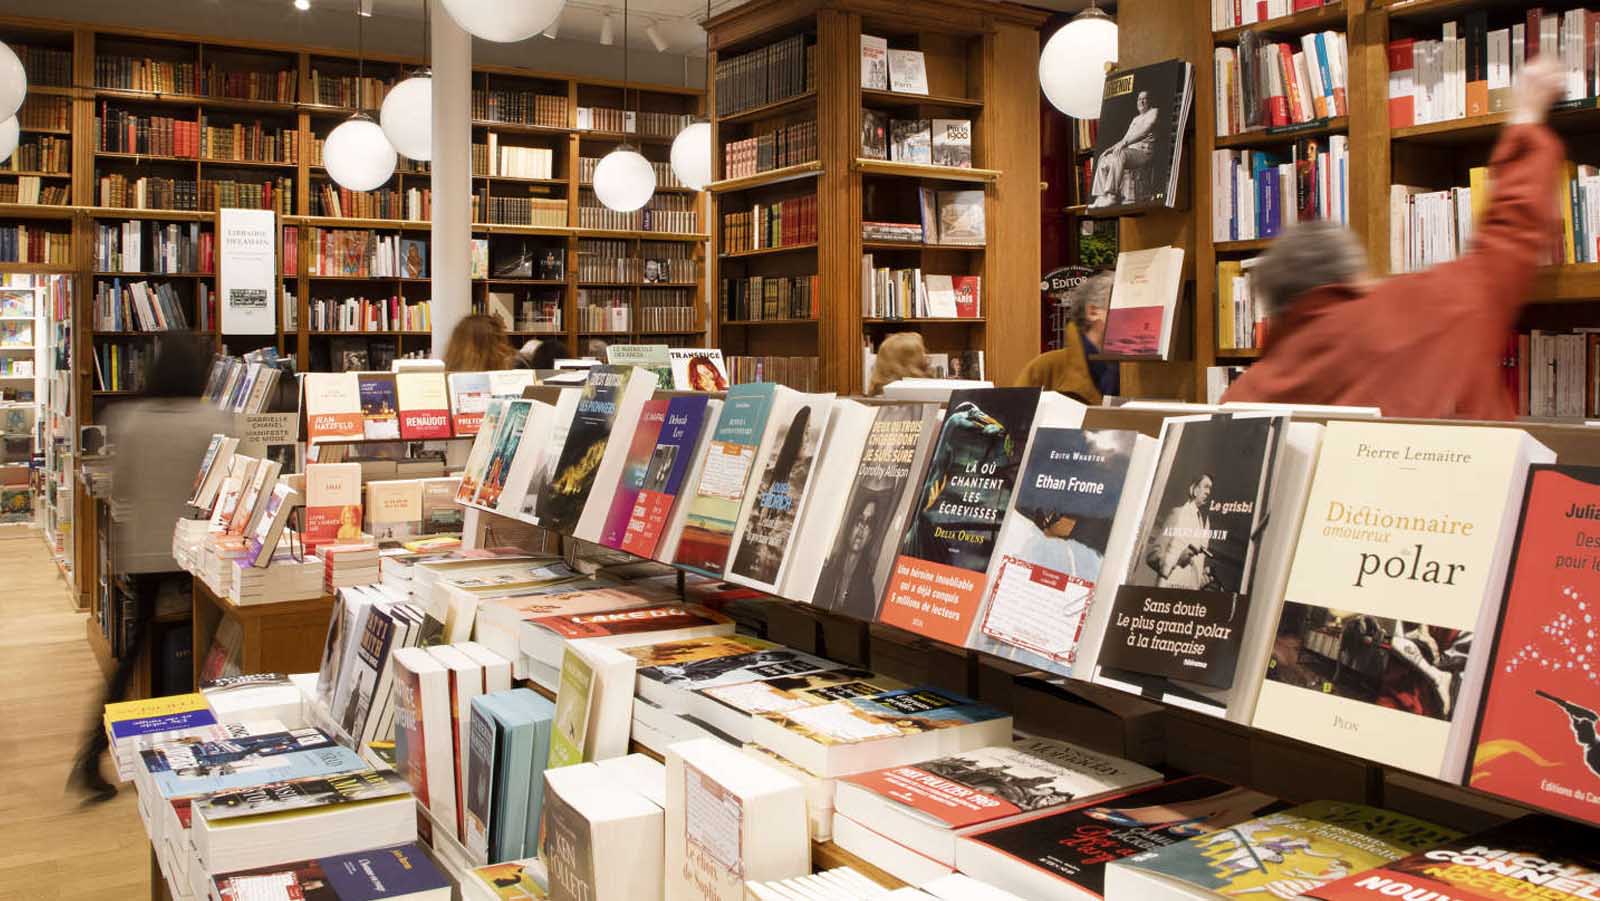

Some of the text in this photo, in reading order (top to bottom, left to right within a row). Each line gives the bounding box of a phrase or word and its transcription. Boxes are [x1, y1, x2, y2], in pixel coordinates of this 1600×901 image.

[315, 422, 353, 430] HATZFELD
[406, 416, 447, 426] RENAUDOT
[1356, 443, 1400, 460] Pierre
[859, 463, 909, 480] Dorothy Allison
[965, 460, 997, 475] LÀ OÙ
[951, 475, 1005, 490] CHANTENT
[1036, 474, 1105, 494] Ethan Frome
[963, 491, 981, 503] LES
[938, 501, 998, 520] ÉCREVISSES
[1210, 500, 1253, 514] Le grisbi
[1327, 500, 1474, 537] Dictionnaire
[1322, 525, 1392, 544] amoureux
[1576, 530, 1600, 548] Des
[1352, 544, 1465, 587] polar
[1555, 555, 1587, 569] pour
[900, 581, 911, 593] qui
[935, 572, 974, 592] inoubliable
[890, 591, 961, 621] 5 millions de lecteurs
[1143, 597, 1207, 618] Sans doute
[1116, 613, 1232, 641] Le plus grand polar
[1127, 632, 1206, 656] à la française
[1540, 779, 1573, 797] Éditions
[1573, 788, 1586, 800] du
[555, 830, 576, 869] KEN
[1424, 850, 1600, 901] CONNEL
[1461, 845, 1600, 887] MICHA
